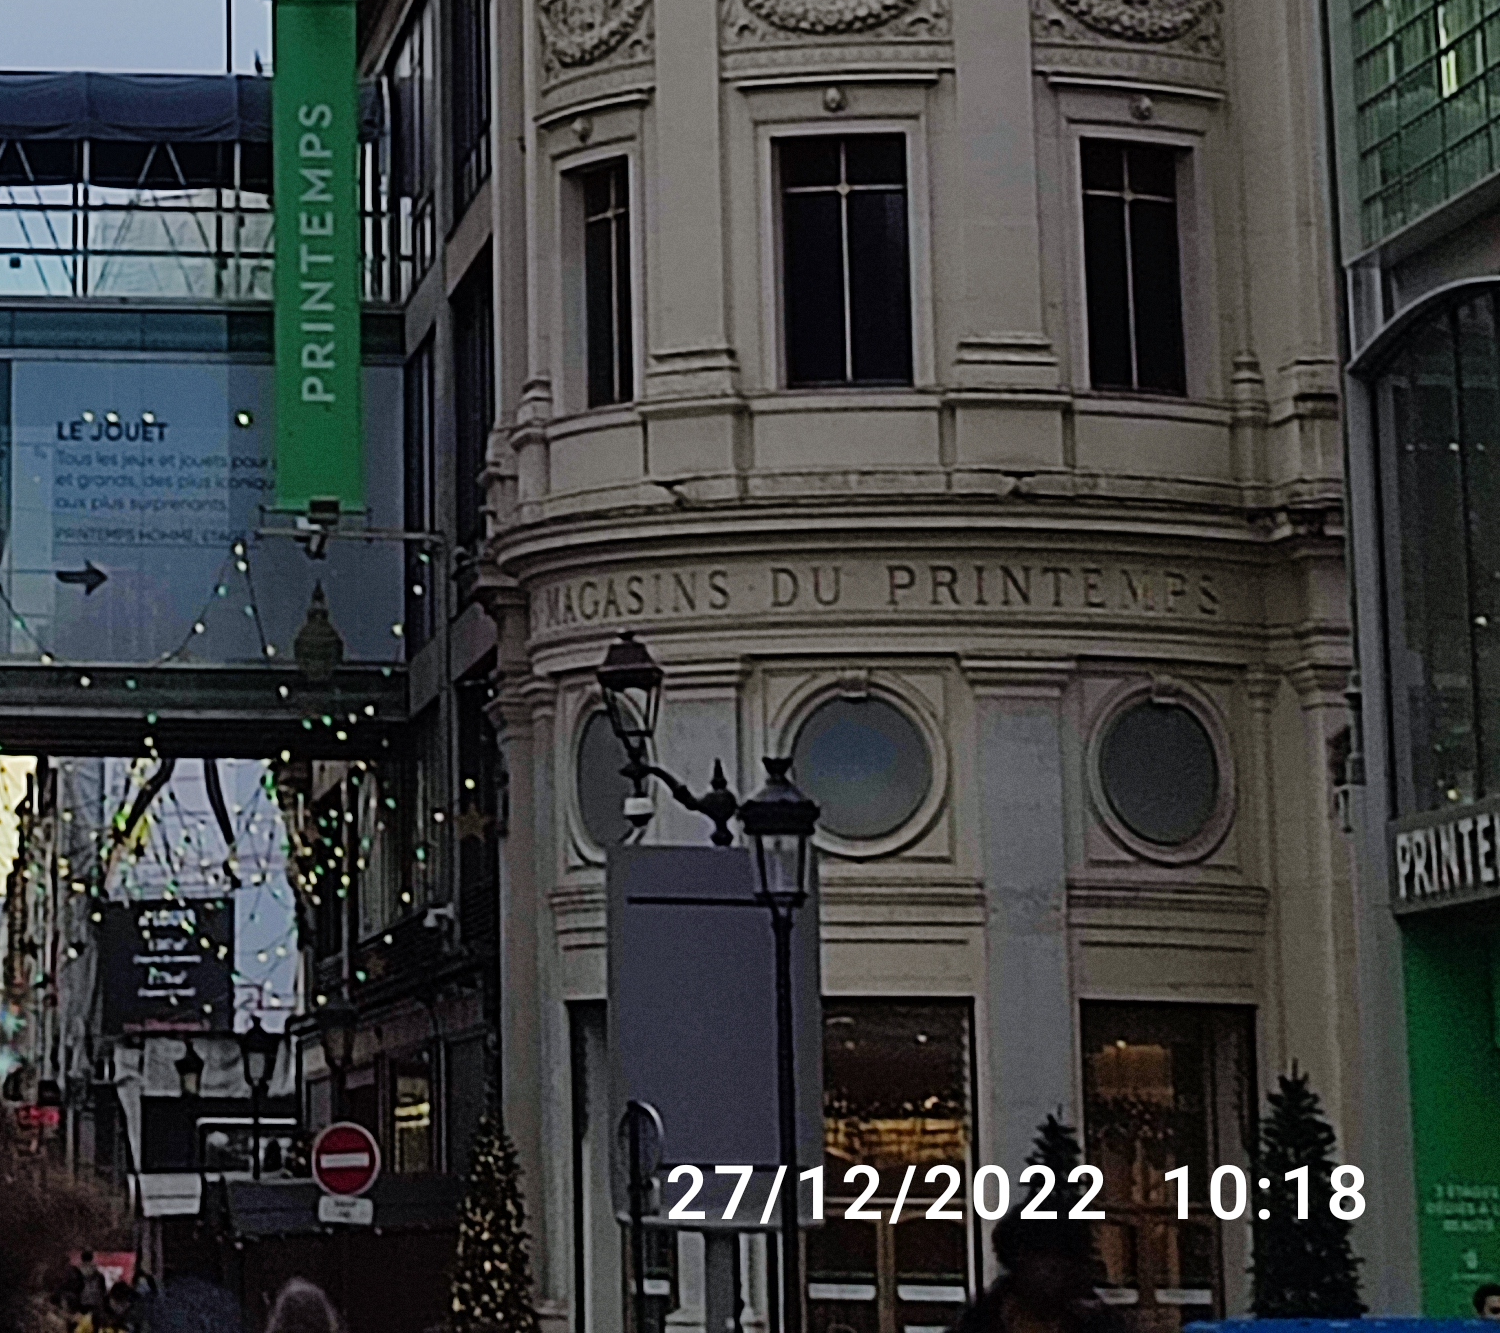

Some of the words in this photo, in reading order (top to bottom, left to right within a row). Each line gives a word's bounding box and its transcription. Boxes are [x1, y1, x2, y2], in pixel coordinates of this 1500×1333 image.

[302, 101, 337, 405] PRINTEMPS
[57, 420, 83, 442] LE
[91, 420, 168, 443] JOUET
[547, 568, 731, 627] MAGASINS
[770, 566, 842, 607] DU
[885, 563, 1220, 616] PRINTEMPS
[1396, 813, 1500, 900] PRINTE
